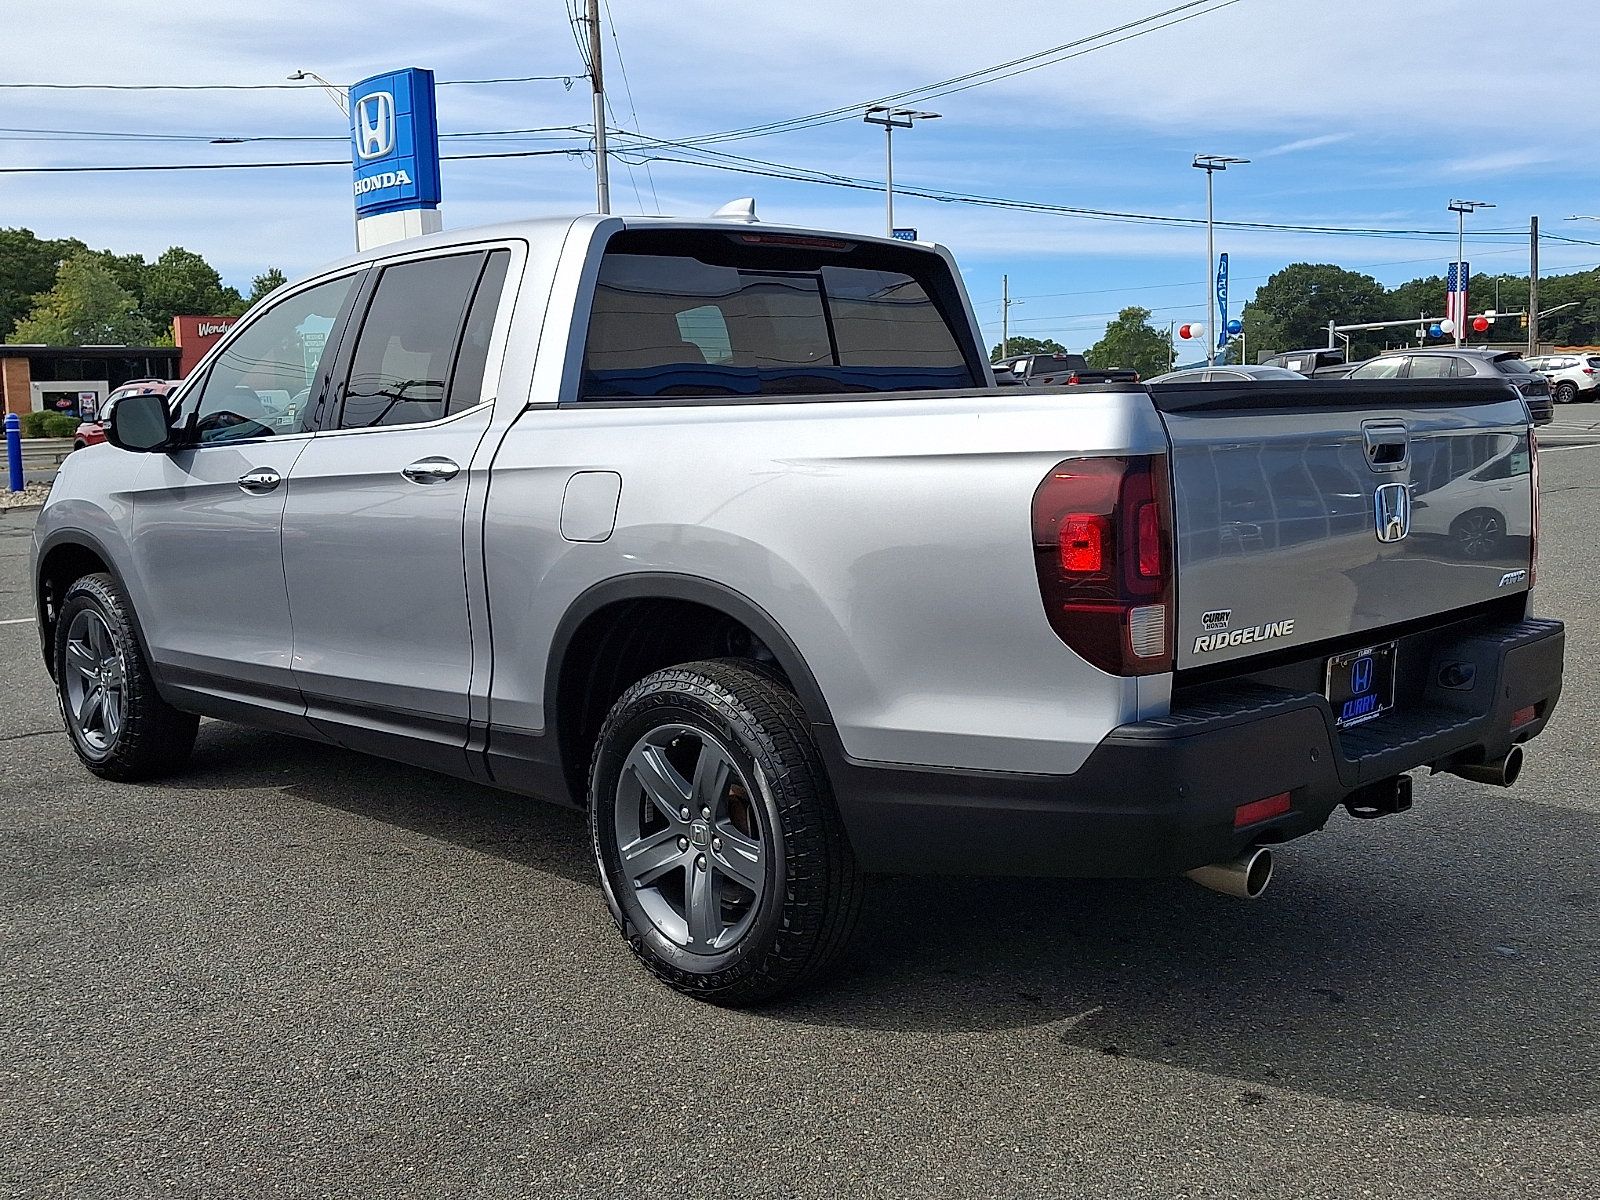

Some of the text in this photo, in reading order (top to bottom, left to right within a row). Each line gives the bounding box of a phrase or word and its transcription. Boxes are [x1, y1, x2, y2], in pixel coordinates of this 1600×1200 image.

[353, 169, 413, 196] HONDA
[1203, 611, 1231, 623] CURRY
[1206, 621, 1227, 630] HONDA
[1192, 619, 1295, 654] RIDGELINE
[1342, 693, 1378, 719] CURRY
